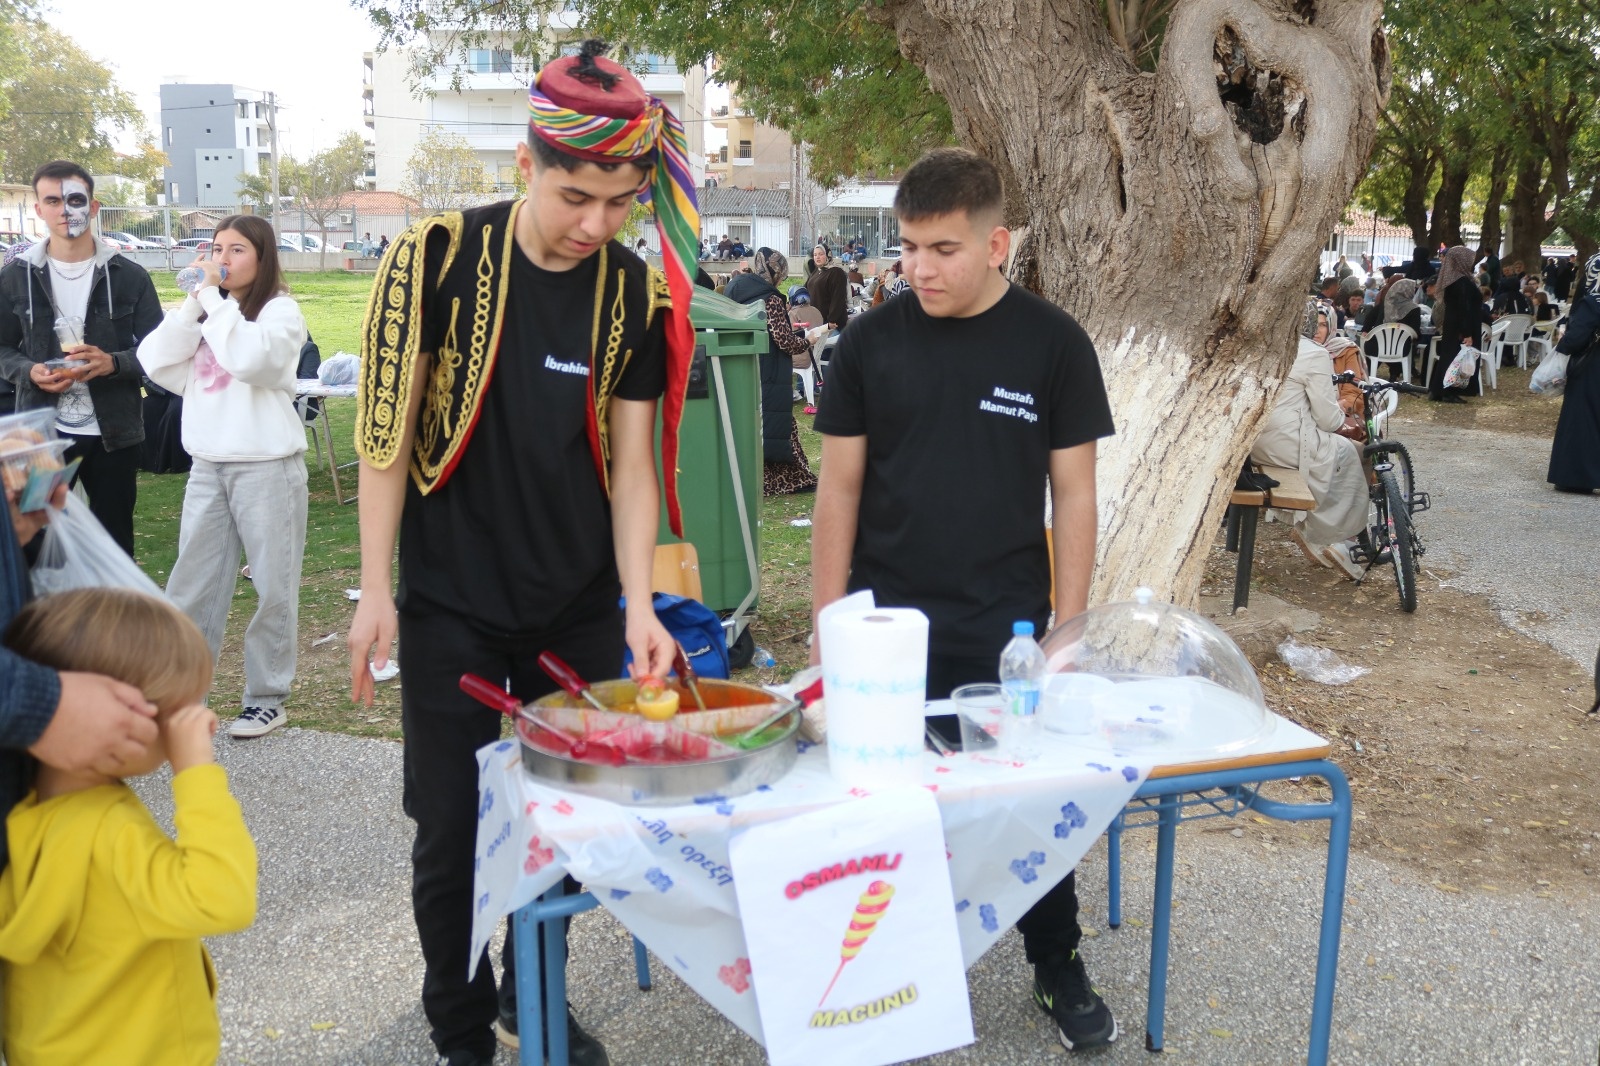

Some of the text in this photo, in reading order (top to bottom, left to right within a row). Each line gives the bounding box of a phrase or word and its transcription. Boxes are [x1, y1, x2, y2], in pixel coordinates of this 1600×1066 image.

[980, 400, 1038, 423] Mamut Paşa
[993, 386, 1034, 405] Mustafa
[784, 853, 903, 900] OSMANLI
[808, 983, 919, 1029] MACUNU
